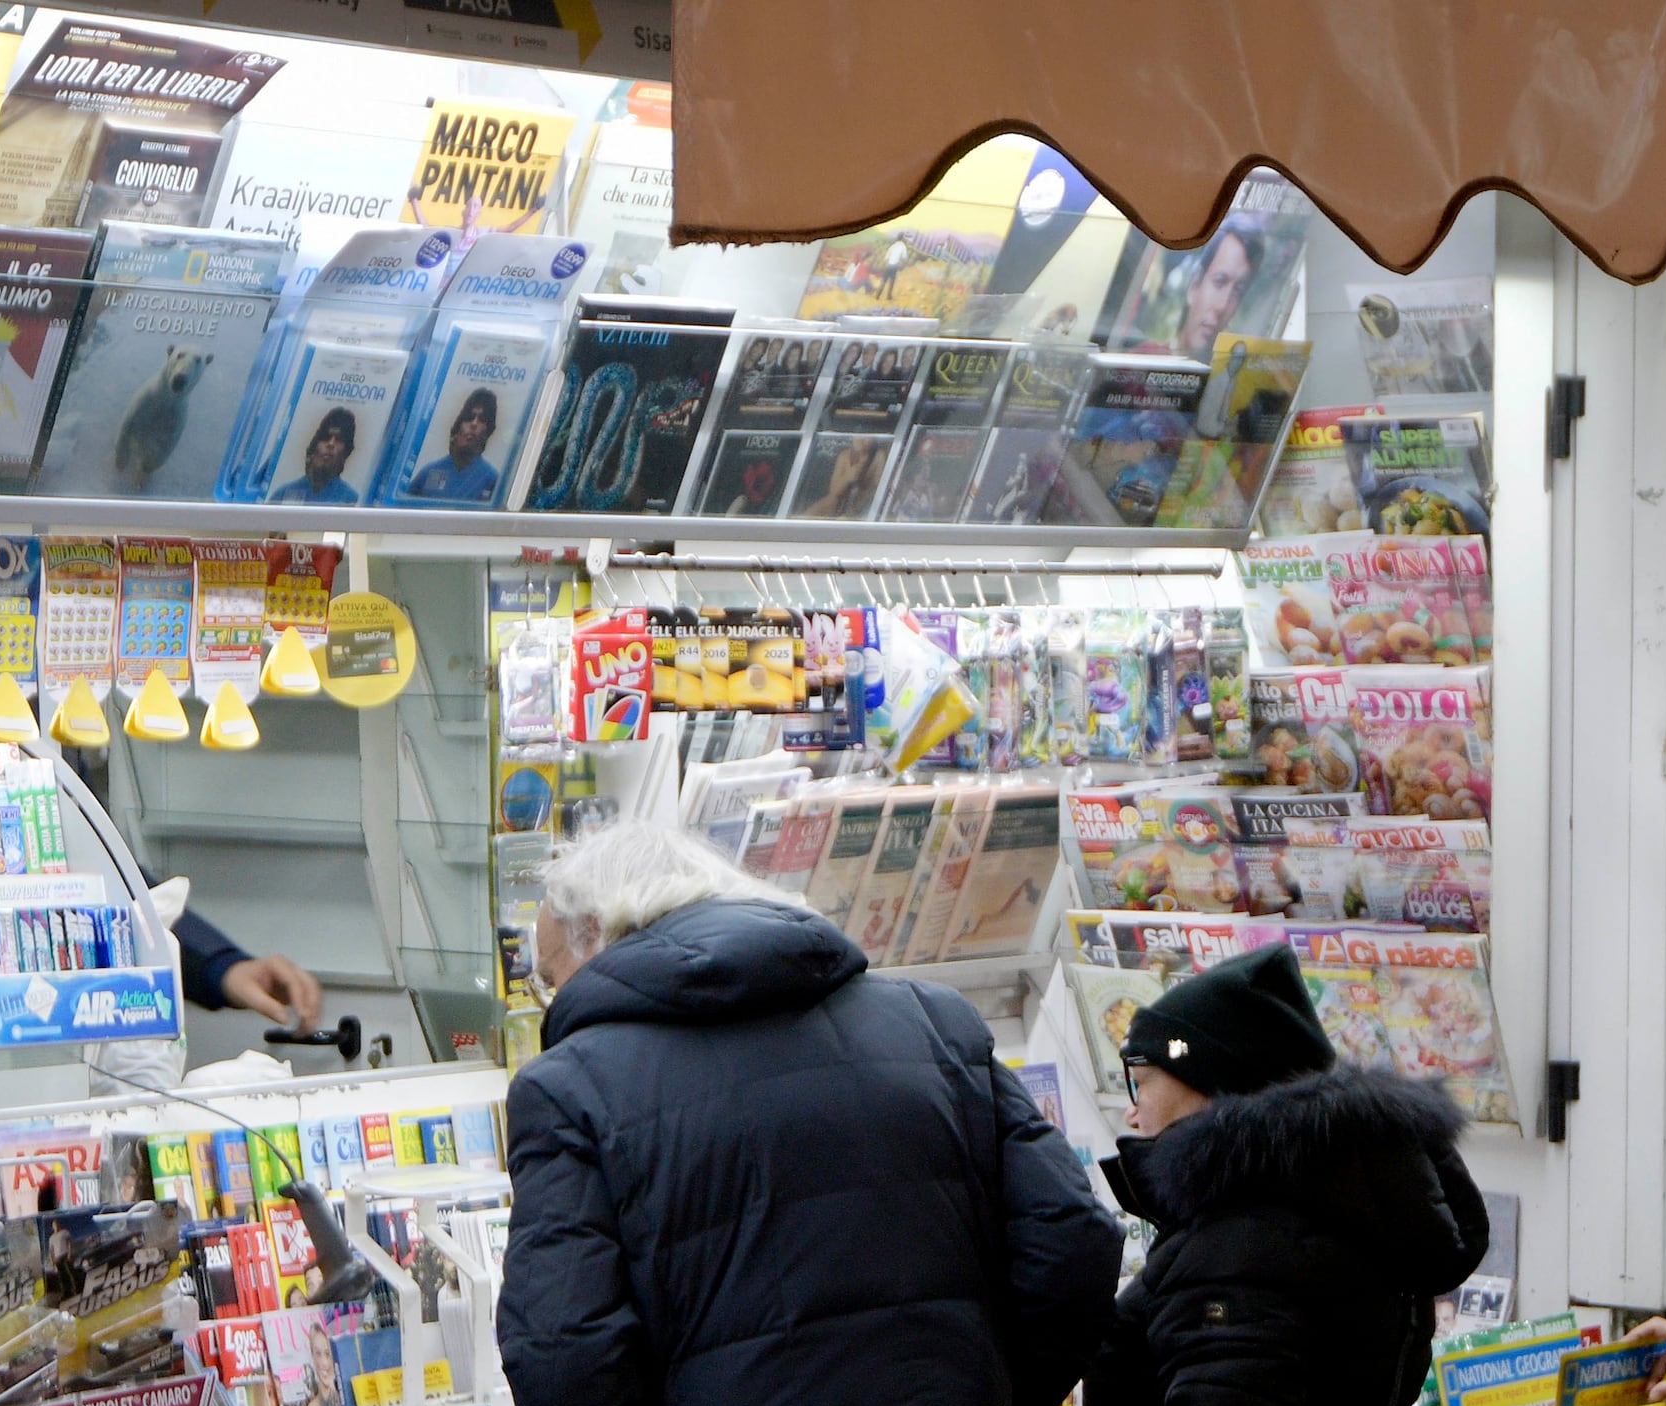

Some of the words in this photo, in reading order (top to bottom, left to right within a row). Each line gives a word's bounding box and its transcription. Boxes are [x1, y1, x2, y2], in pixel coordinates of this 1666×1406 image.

[35, 55, 93, 83] LOTTA
[94, 61, 131, 89] PER
[133, 67, 159, 94] LA
[160, 69, 250, 104] LIBERTÀ
[55, 89, 66, 100] LA
[67, 91, 89, 102] VERA
[91, 92, 122, 104] STORIA
[430, 112, 539, 163] MARCO
[115, 160, 198, 193] CONVOGLIO
[418, 160, 547, 211] PANTANI
[145, 189, 159, 202] 53
[230, 175, 392, 226] Kraaijvanger
[603, 187, 629, 203] che
[631, 191, 659, 206] non
[208, 254, 255, 272] NATIONAL
[367, 255, 402, 268] DIEGO
[204, 269, 265, 286] GEOGRAPHIC
[322, 264, 429, 292] MARADONA
[500, 265, 535, 278] DIEGO
[456, 276, 562, 300] MARADONA
[104, 292, 122, 308] IL
[124, 294, 255, 318] RISCALDAMENTO
[133, 315, 219, 337] GLOBALE
[484, 354, 508, 366] DIEGO
[935, 350, 999, 383] QUEEN
[339, 372, 366, 383] DIEGO
[456, 362, 527, 383] MARADONA
[1146, 372, 1201, 389] FOTOGRAFIA
[311, 380, 386, 400] MARADONA
[195, 547, 266, 561] TOMBOLA
[290, 544, 314, 564] 10X
[1244, 545, 1314, 560] CUCINA
[500, 590, 518, 605] Apri
[333, 603, 367, 612] ATTIVA
[370, 603, 389, 611] QUI
[354, 630, 391, 642] SisalPay
[702, 648, 727, 659] 2016
[763, 648, 790, 659] 2025
[584, 642, 648, 686] UNO
[1364, 690, 1468, 722] DOLCI
[1243, 802, 1265, 817] LA
[1267, 803, 1340, 817] CUCINA
[1075, 822, 1138, 840] CUCINA
[1410, 902, 1473, 918] DOLCE
[1347, 940, 1381, 964] Ci
[1387, 941, 1475, 968] piace
[120, 991, 154, 1005] Action
[73, 990, 116, 1026] AIR
[119, 1010, 157, 1025] Vigorsol
[59, 1263, 171, 1317] FURIOUS
[226, 1325, 263, 1356] Love
[235, 1349, 268, 1377] Story
[1579, 1355, 1639, 1385] NATIONAL
[1459, 1360, 1512, 1386] NATIONAL
